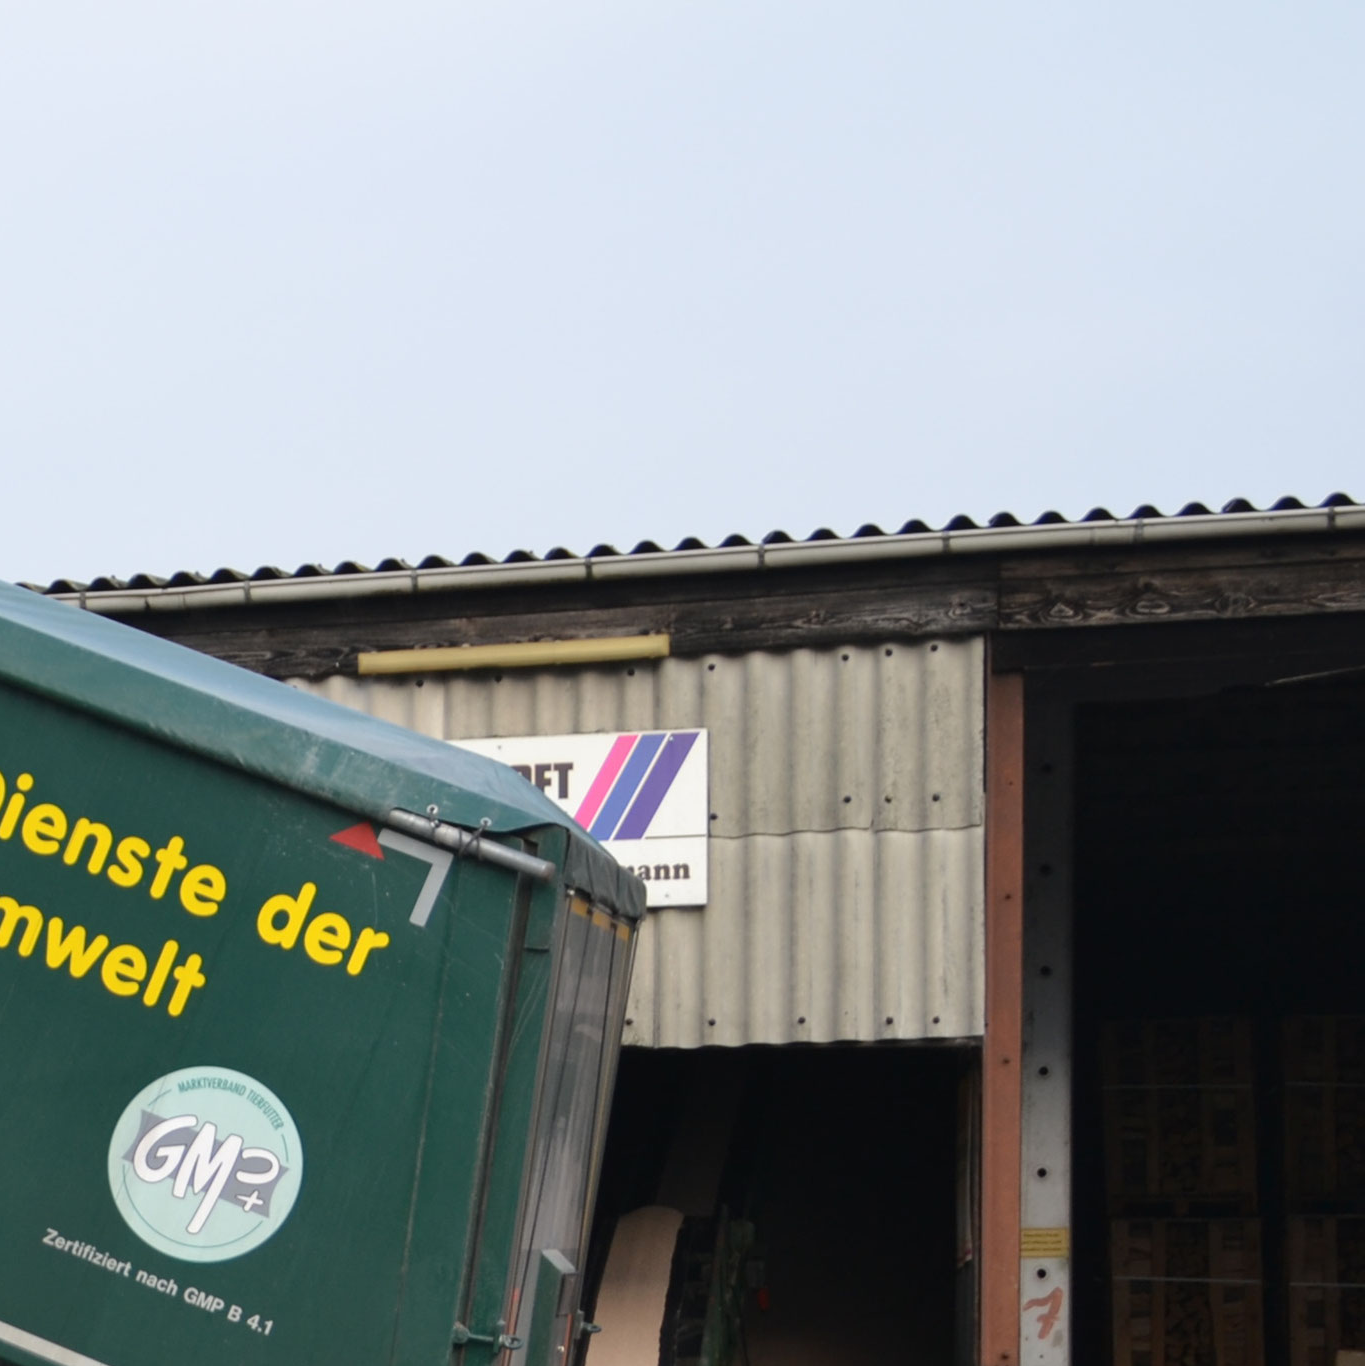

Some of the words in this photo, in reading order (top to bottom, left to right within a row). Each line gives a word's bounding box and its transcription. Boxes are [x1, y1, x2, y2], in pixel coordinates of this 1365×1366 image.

[256, 881, 390, 977] der
[177, 1077, 247, 1097] MARKTVERBAND
[41, 1227, 132, 1278] Zertifiziert
[135, 1269, 179, 1296] nach
[183, 1286, 225, 1314] GMP
[226, 1304, 243, 1323] B
[246, 1314, 274, 1336] 4.1
